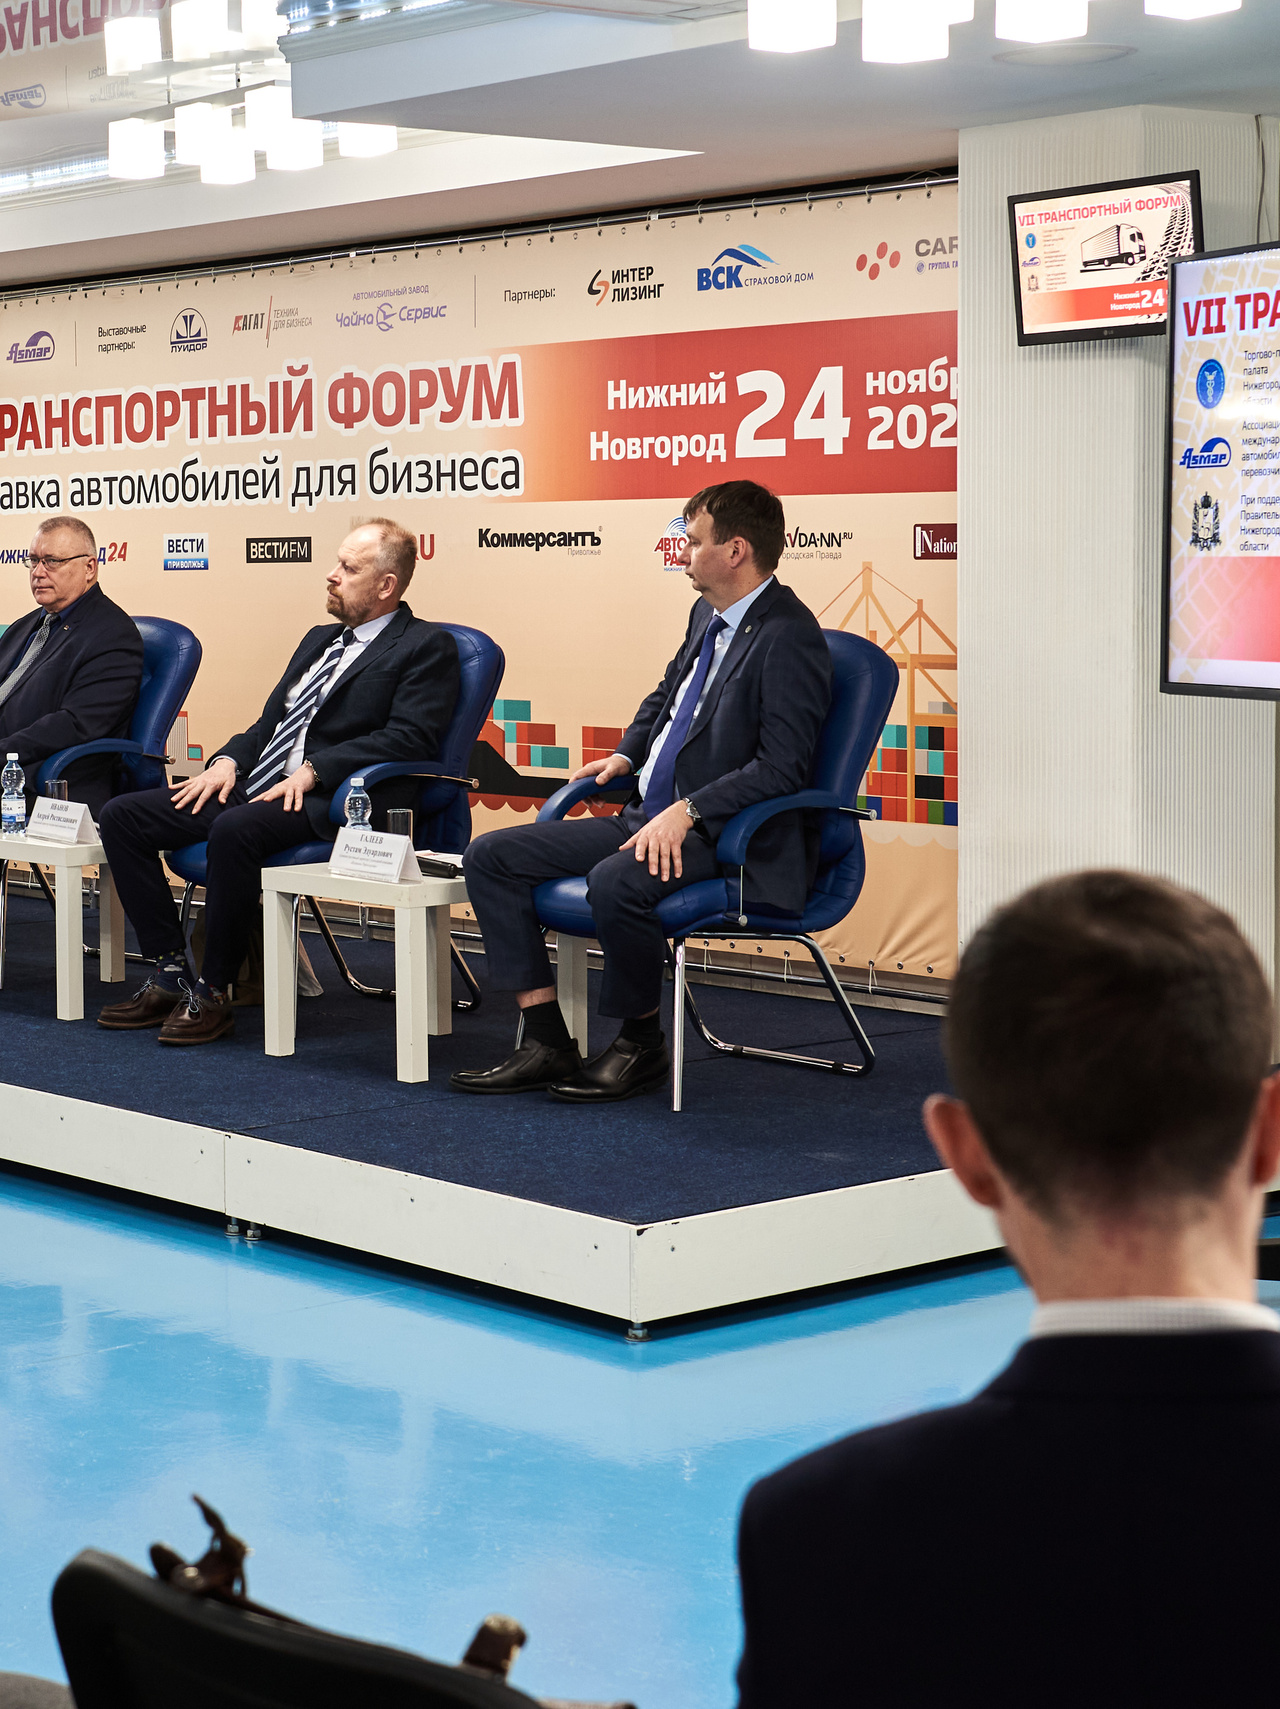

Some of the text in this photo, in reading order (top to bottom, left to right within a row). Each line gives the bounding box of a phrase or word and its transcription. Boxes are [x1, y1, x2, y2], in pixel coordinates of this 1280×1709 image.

[1037, 198, 1132, 225] ТРАНСПОРТНЫЙ
[1134, 194, 1183, 212] ФОРУМ
[610, 266, 654, 284] ИНТЕР
[696, 264, 814, 292] ВСК СТРАХОВОЙ ДОМ
[352, 284, 430, 301] АВТОМОБИЛЬНЫЙ ЗАВОД
[504, 287, 556, 304] Партнеры:
[611, 282, 665, 302] ЛИЗИНГ
[1140, 289, 1165, 308] 24
[273, 308, 299, 319] ТЕХНИКА
[1183, 297, 1226, 337] VII
[98, 324, 146, 338] Выставочные
[273, 318, 312, 331] ДЛЯ БИЗНЕСА
[98, 341, 136, 354] партнеры:
[170, 343, 208, 353] ЛУИДОР
[1243, 366, 1268, 376] палата
[327, 361, 520, 429] ФОРУМ
[607, 371, 726, 410] Нижний
[734, 366, 851, 459] 24
[867, 402, 958, 450] 202
[590, 431, 727, 466] Новгород
[70, 456, 280, 509] автомобилей
[291, 462, 357, 506] для
[368, 447, 520, 494] бизнеса
[1240, 495, 1256, 506] При
[167, 538, 204, 554] ВЕСТИ
[478, 528, 602, 552] Коммерсантъ
[1240, 540, 1269, 551] области
[568, 548, 602, 558] Приволжье
[816, 550, 842, 560] Правда
[167, 560, 205, 570] ПРИВОЛЖЬЕ
[360, 834, 384, 844] ГАЛЕЕВ
